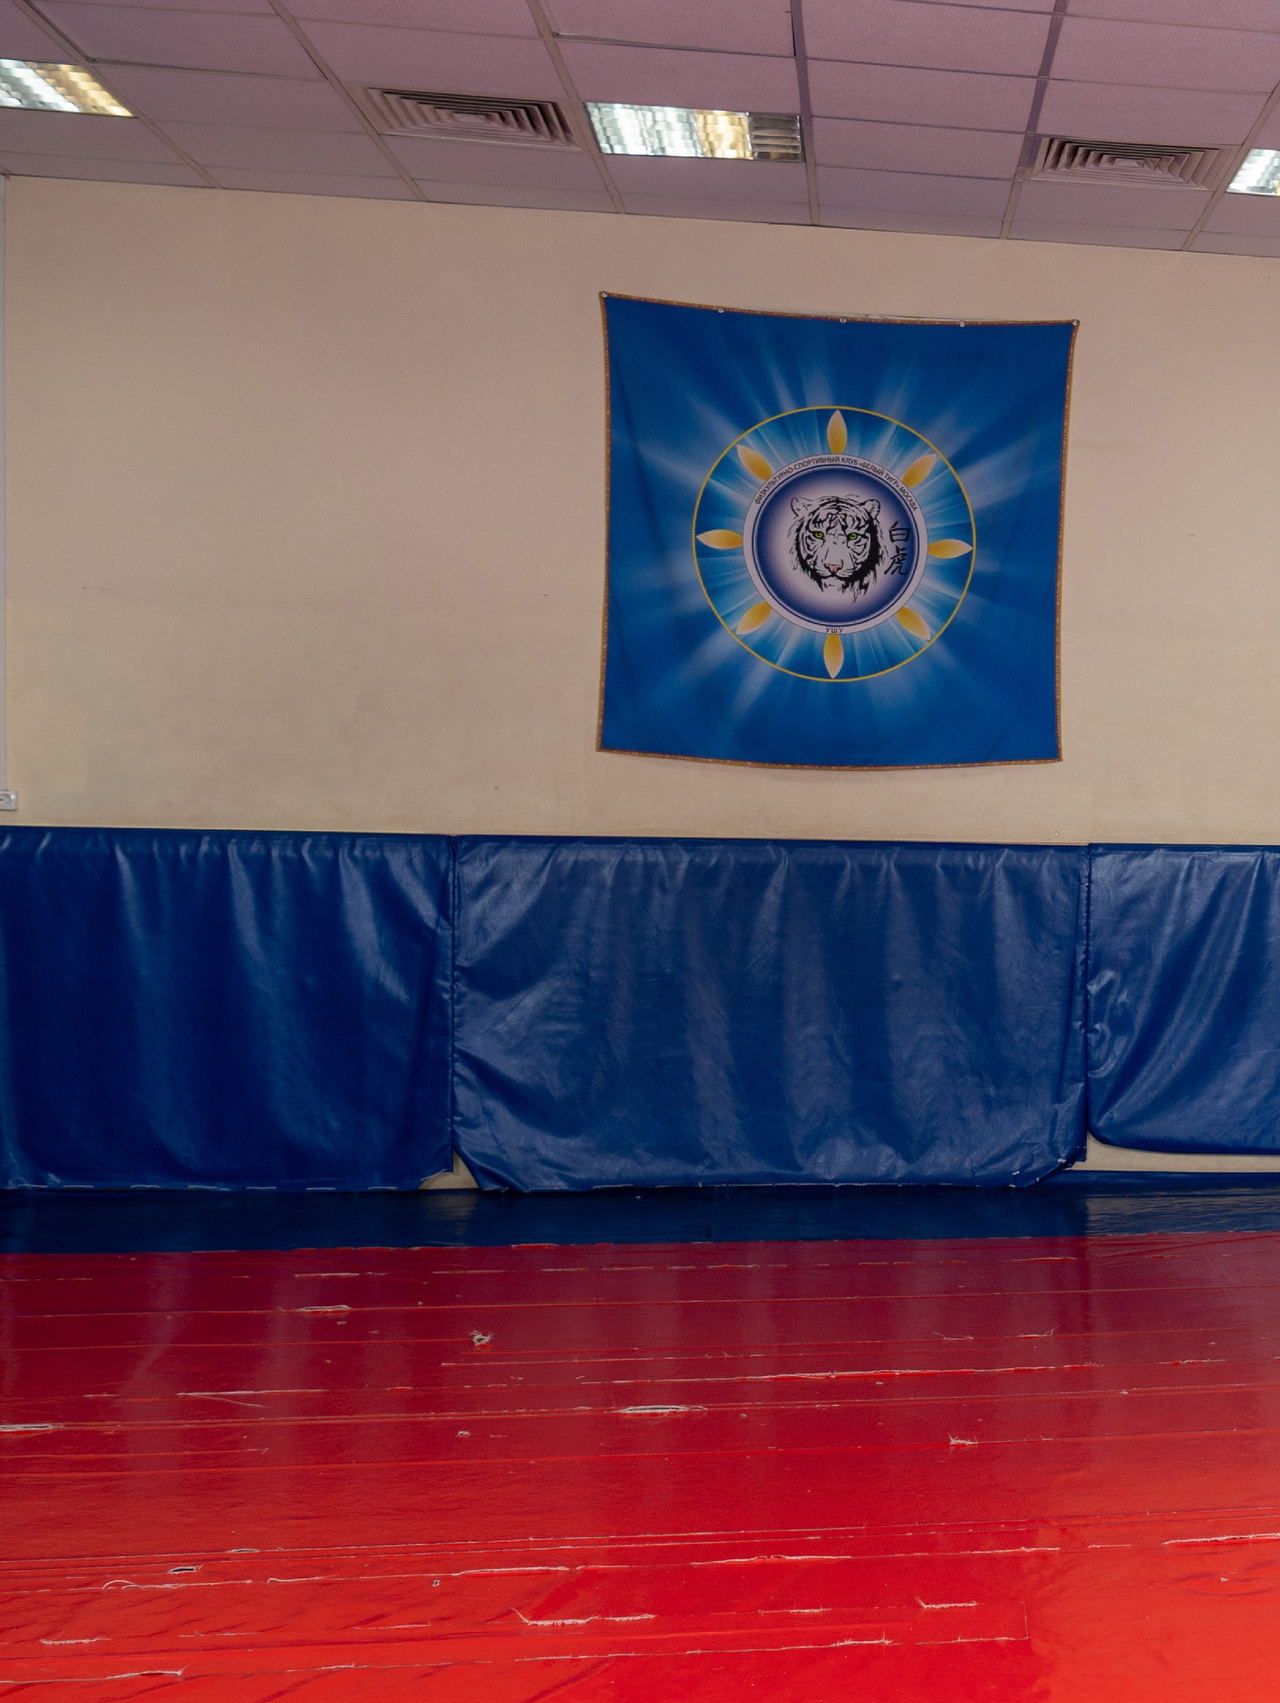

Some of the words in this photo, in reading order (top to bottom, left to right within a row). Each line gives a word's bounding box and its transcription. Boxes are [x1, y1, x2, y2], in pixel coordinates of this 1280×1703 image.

[754, 455, 841, 505] ФИЗКУЛЬТУРНО-СПОРТИВНЫЙ
[841, 457, 859, 466] КЛУБ
[899, 486, 918, 512] МОСКВА
[884, 521, 911, 576] 白虎
